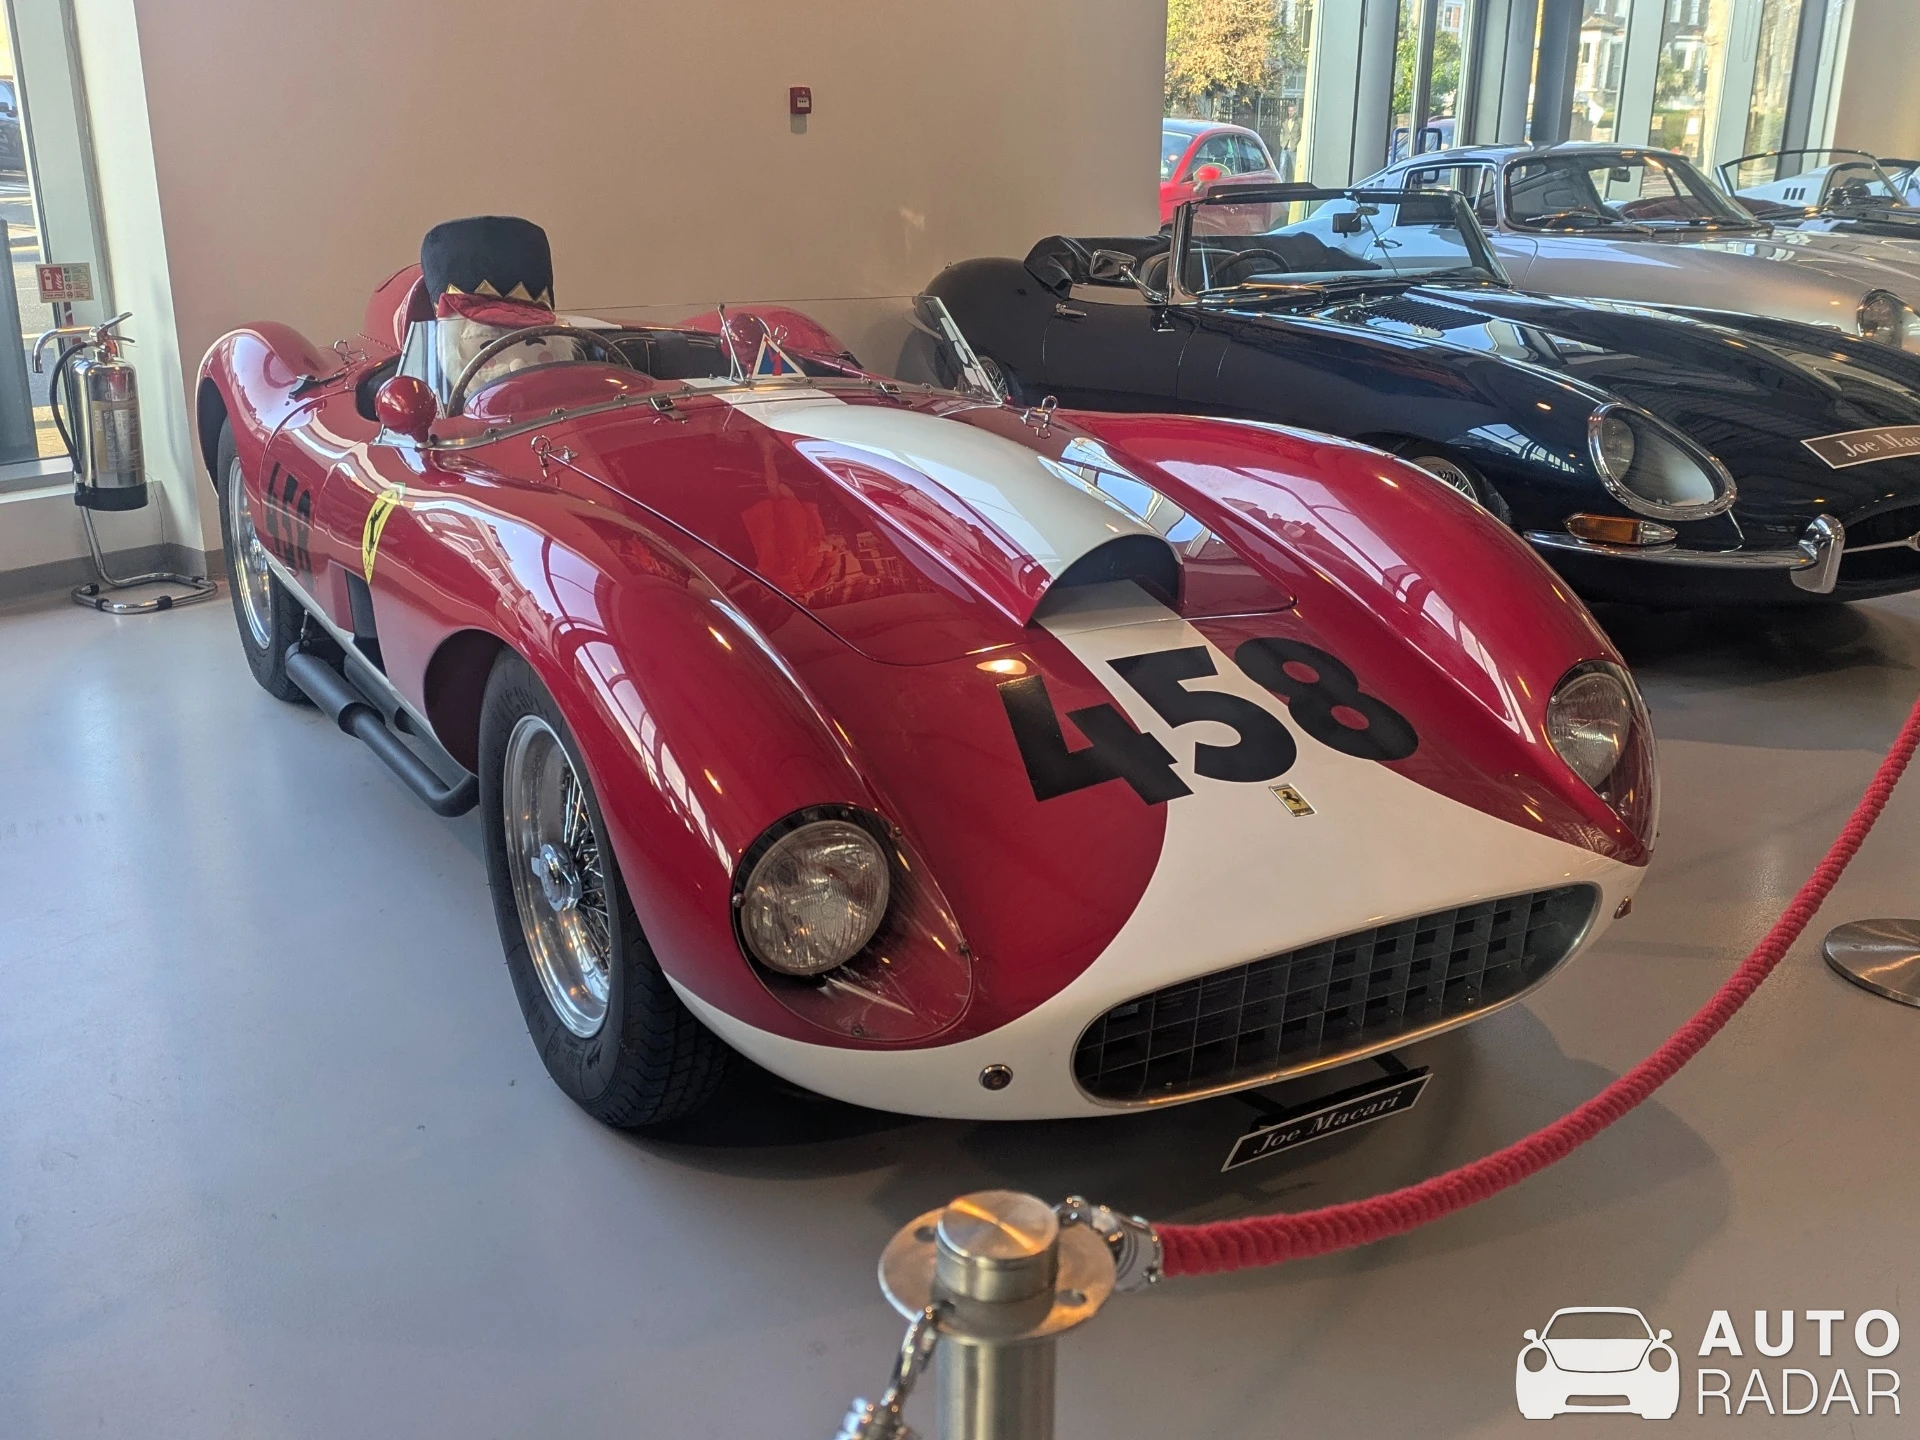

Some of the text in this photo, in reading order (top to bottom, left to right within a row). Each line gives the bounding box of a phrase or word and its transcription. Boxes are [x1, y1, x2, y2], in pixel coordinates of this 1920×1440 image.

[1836, 440, 1880, 458] Joe
[997, 637, 1419, 806] 458
[1253, 1091, 1402, 1154] Joe Macari
